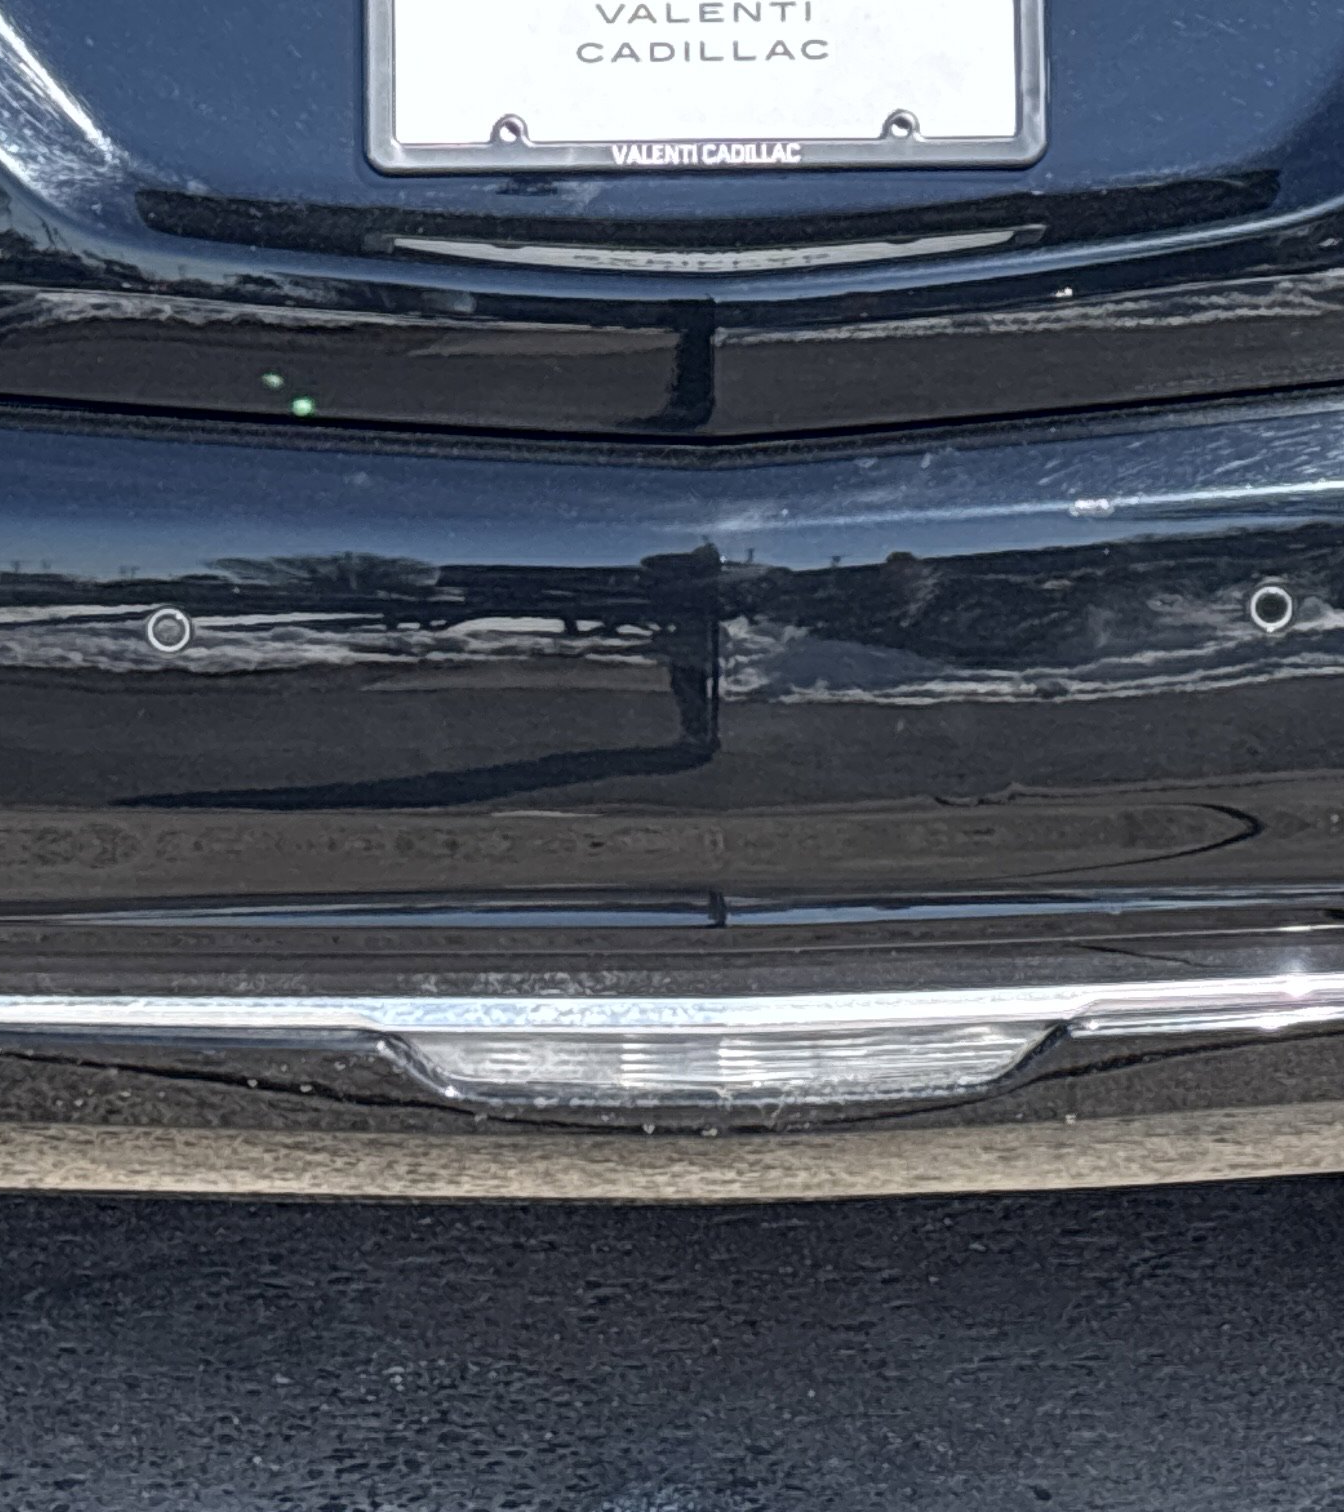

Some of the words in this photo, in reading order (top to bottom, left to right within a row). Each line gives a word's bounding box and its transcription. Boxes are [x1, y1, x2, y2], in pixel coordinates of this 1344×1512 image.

[595, 1, 812, 24] VALENTI
[576, 39, 830, 64] CADILLAC
[611, 144, 698, 165] VALENTI
[702, 143, 802, 164] CADILLAC
